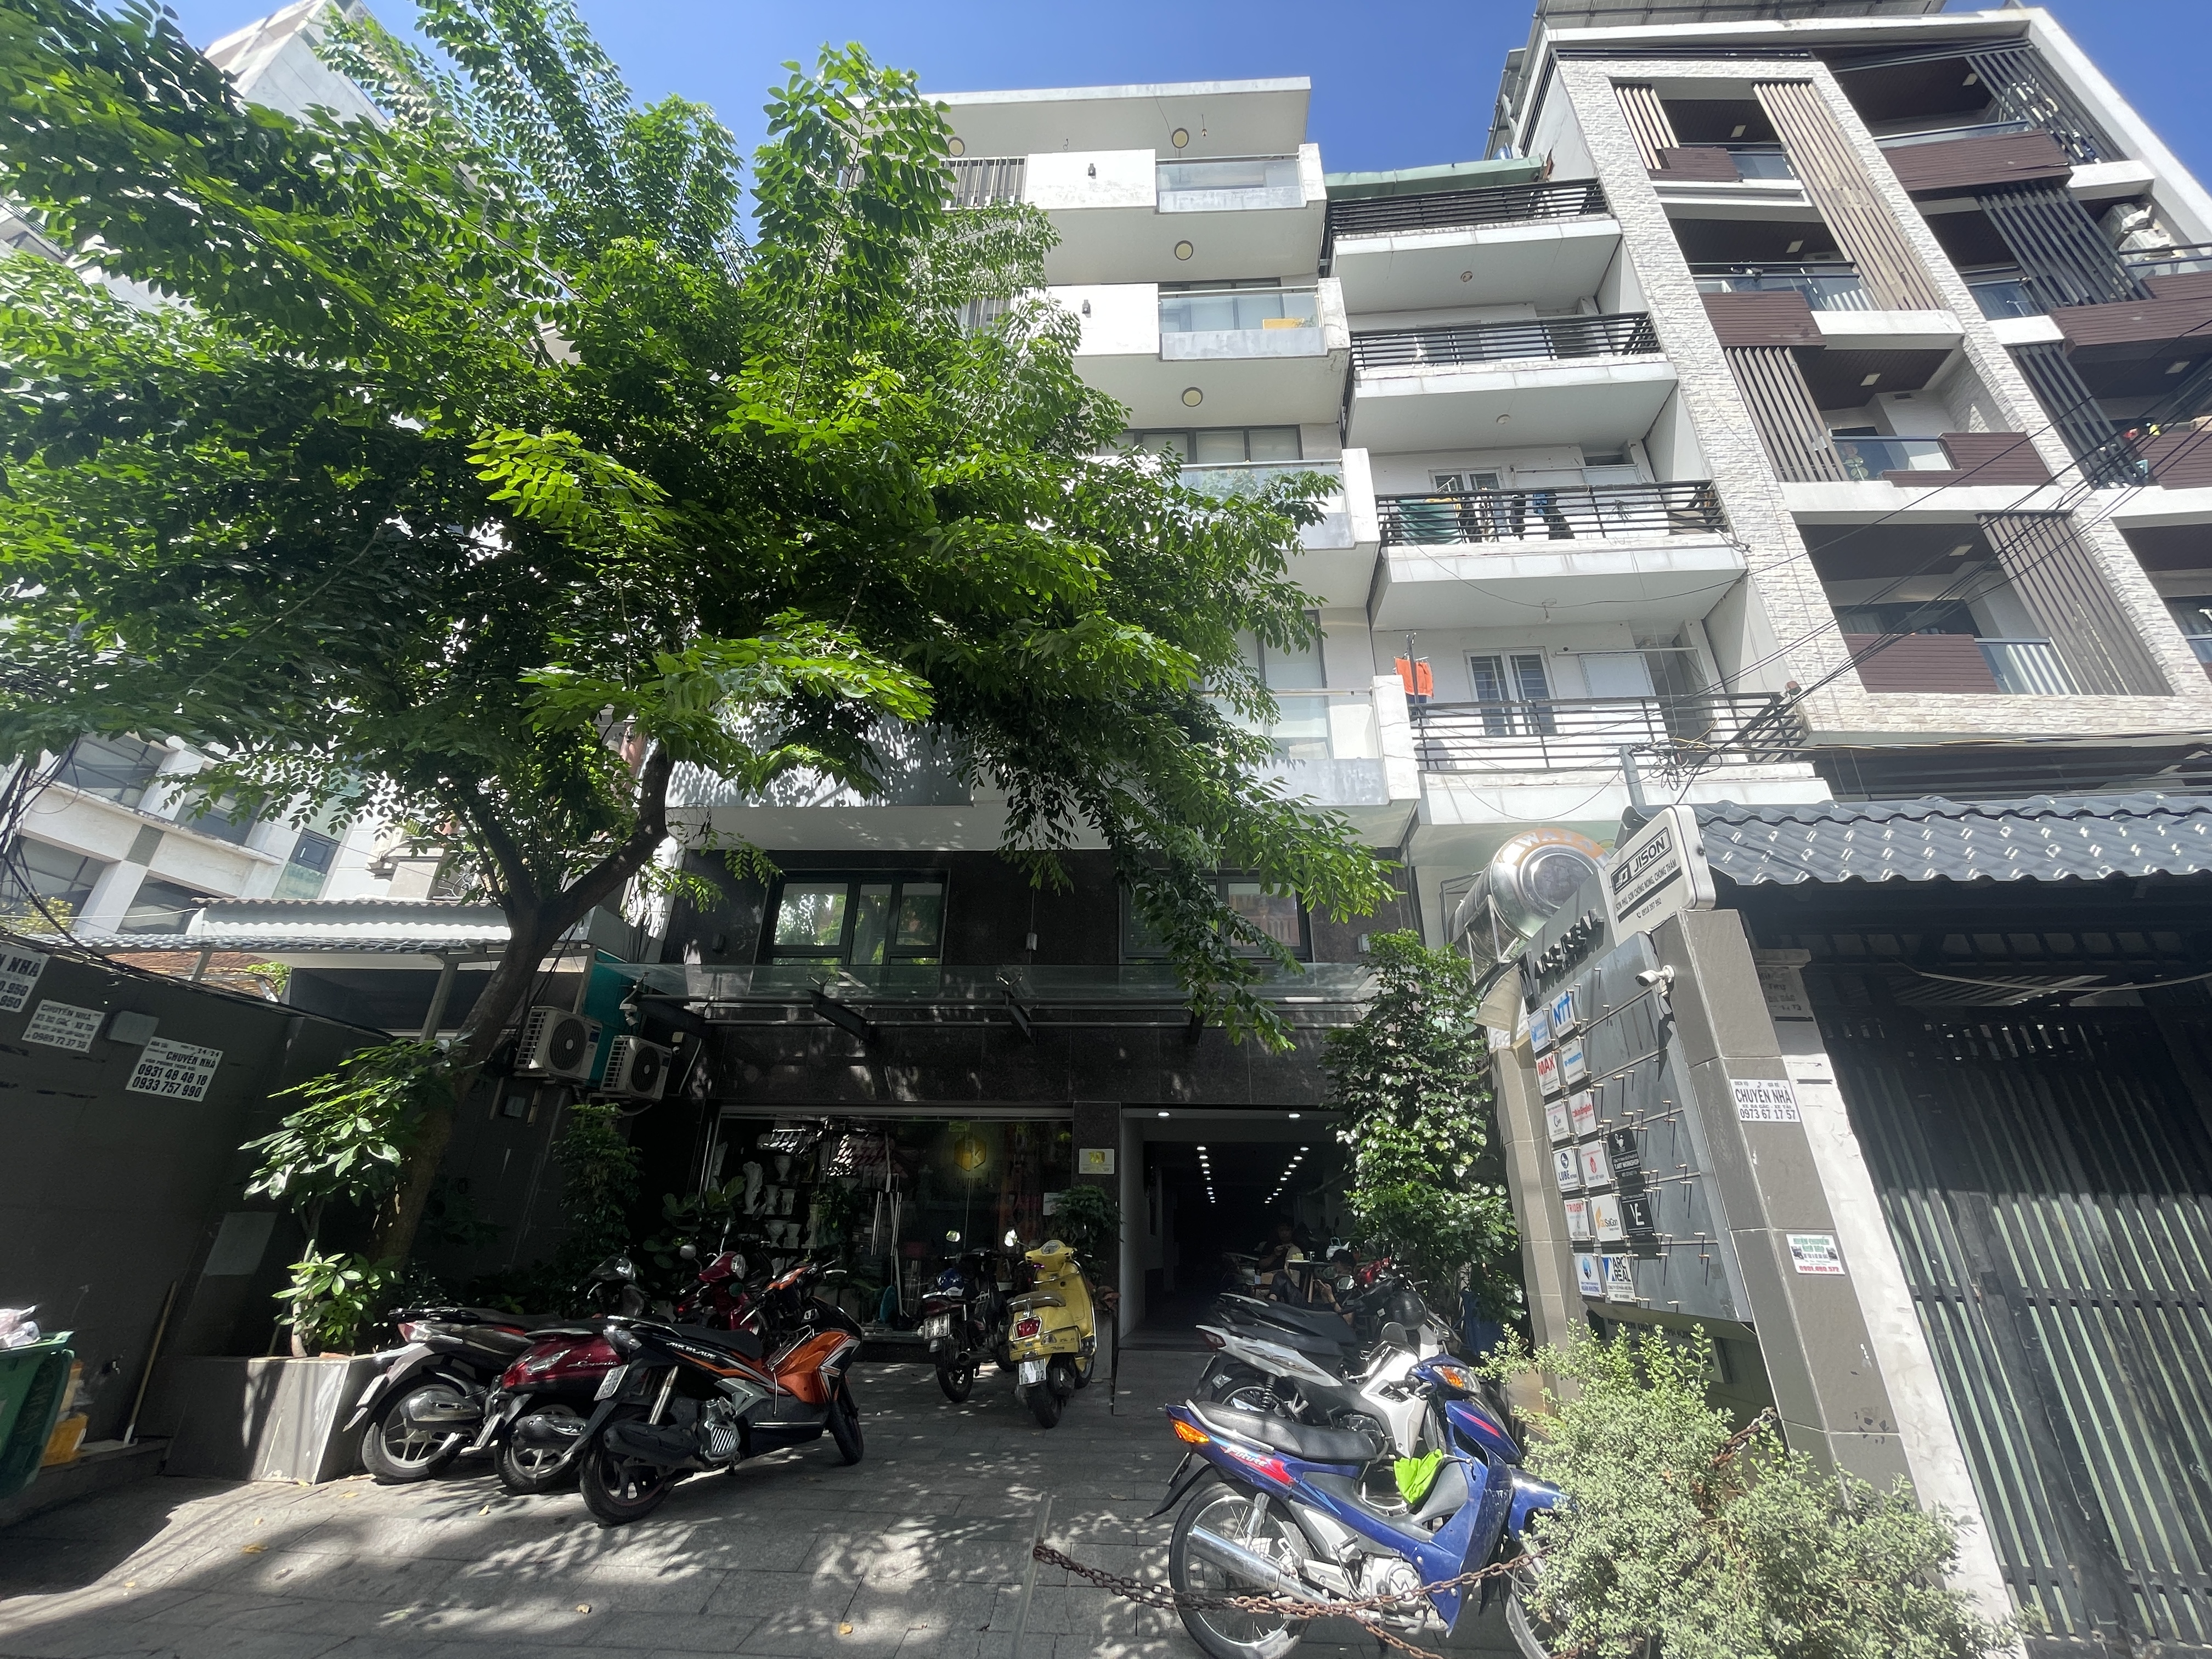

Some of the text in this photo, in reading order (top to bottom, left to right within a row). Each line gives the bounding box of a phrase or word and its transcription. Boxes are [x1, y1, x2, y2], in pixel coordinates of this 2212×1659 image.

[1634, 837, 1665, 872] JISON
[1553, 995, 1570, 1028] NTT
[138, 1064, 164, 1078] 0931
[1538, 1056, 1555, 1076] MAX
[132, 1076, 161, 1091] 0933
[161, 1081, 182, 1094] 757
[1735, 1081, 1792, 1103] CHUYỂN NHÀ
[1740, 1109, 1796, 1119] 0973 67 17 57
[1558, 1170, 1570, 1181] LUBE
[1615, 1269, 1632, 1282] REAL
[1224, 1446, 1268, 1468] Future
